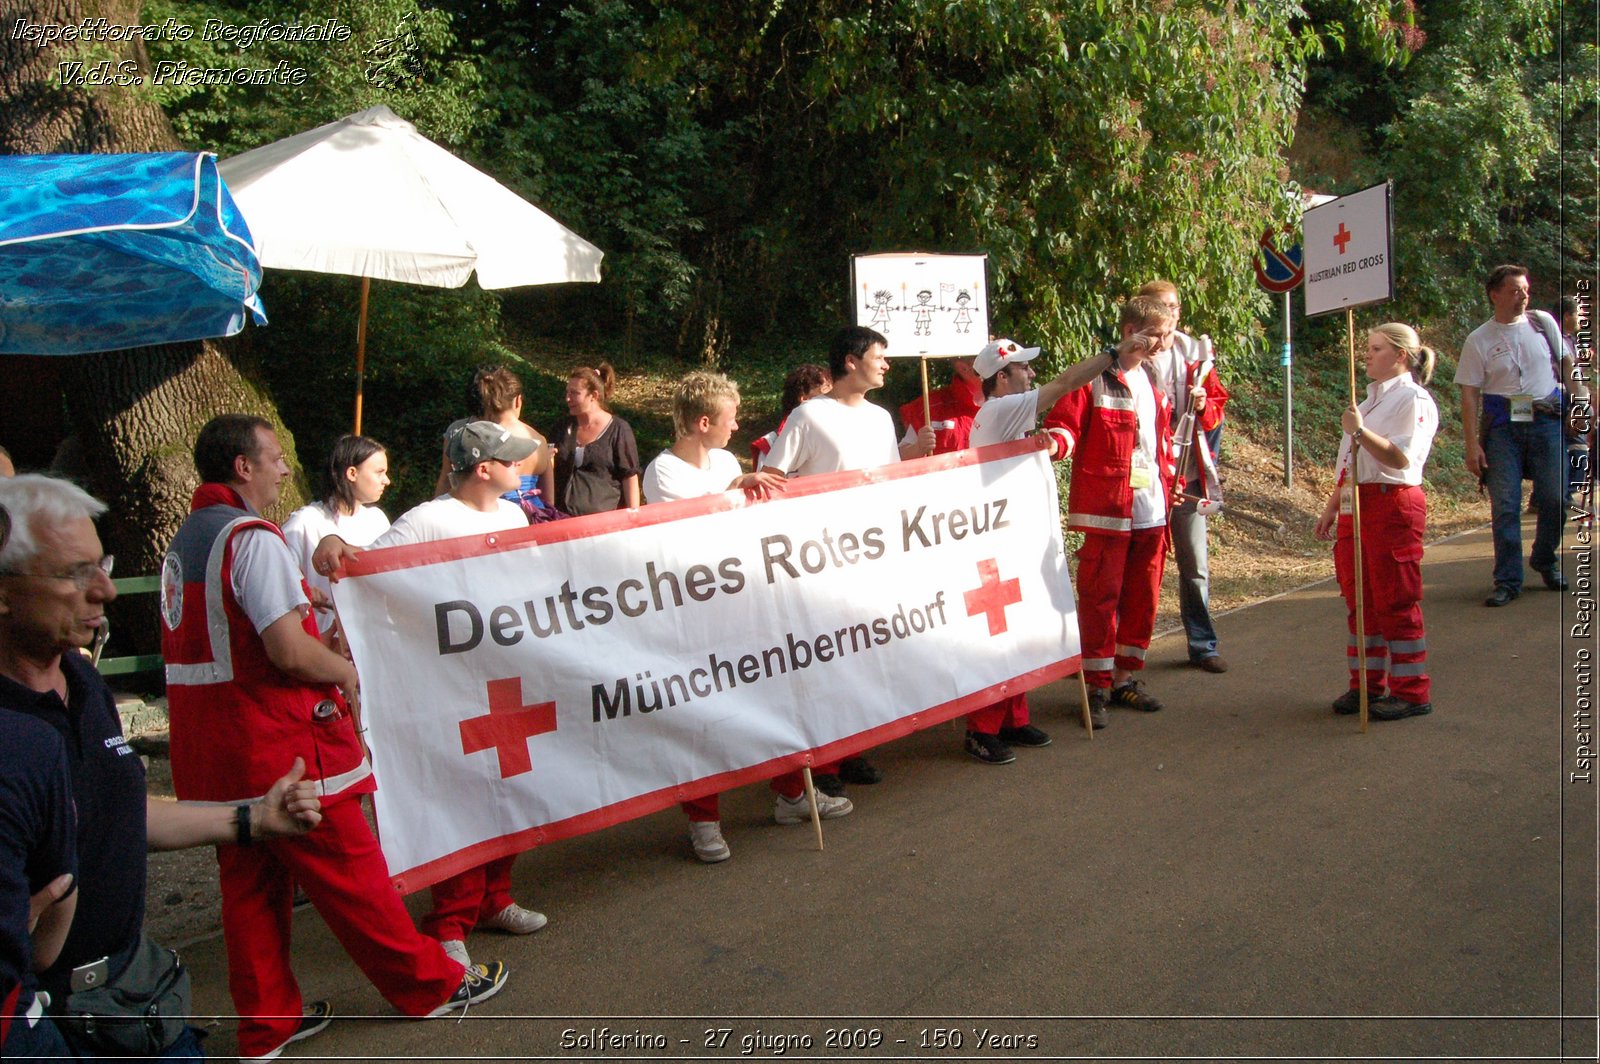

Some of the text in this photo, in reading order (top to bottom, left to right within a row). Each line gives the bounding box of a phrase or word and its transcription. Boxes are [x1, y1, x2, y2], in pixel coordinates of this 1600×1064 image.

[1308, 253, 1384, 284] AUSTRIAN RED CROSS
[436, 497, 1012, 656] Deutsches Rotes Kreuz
[591, 591, 947, 723] Münchenbernsdorf
